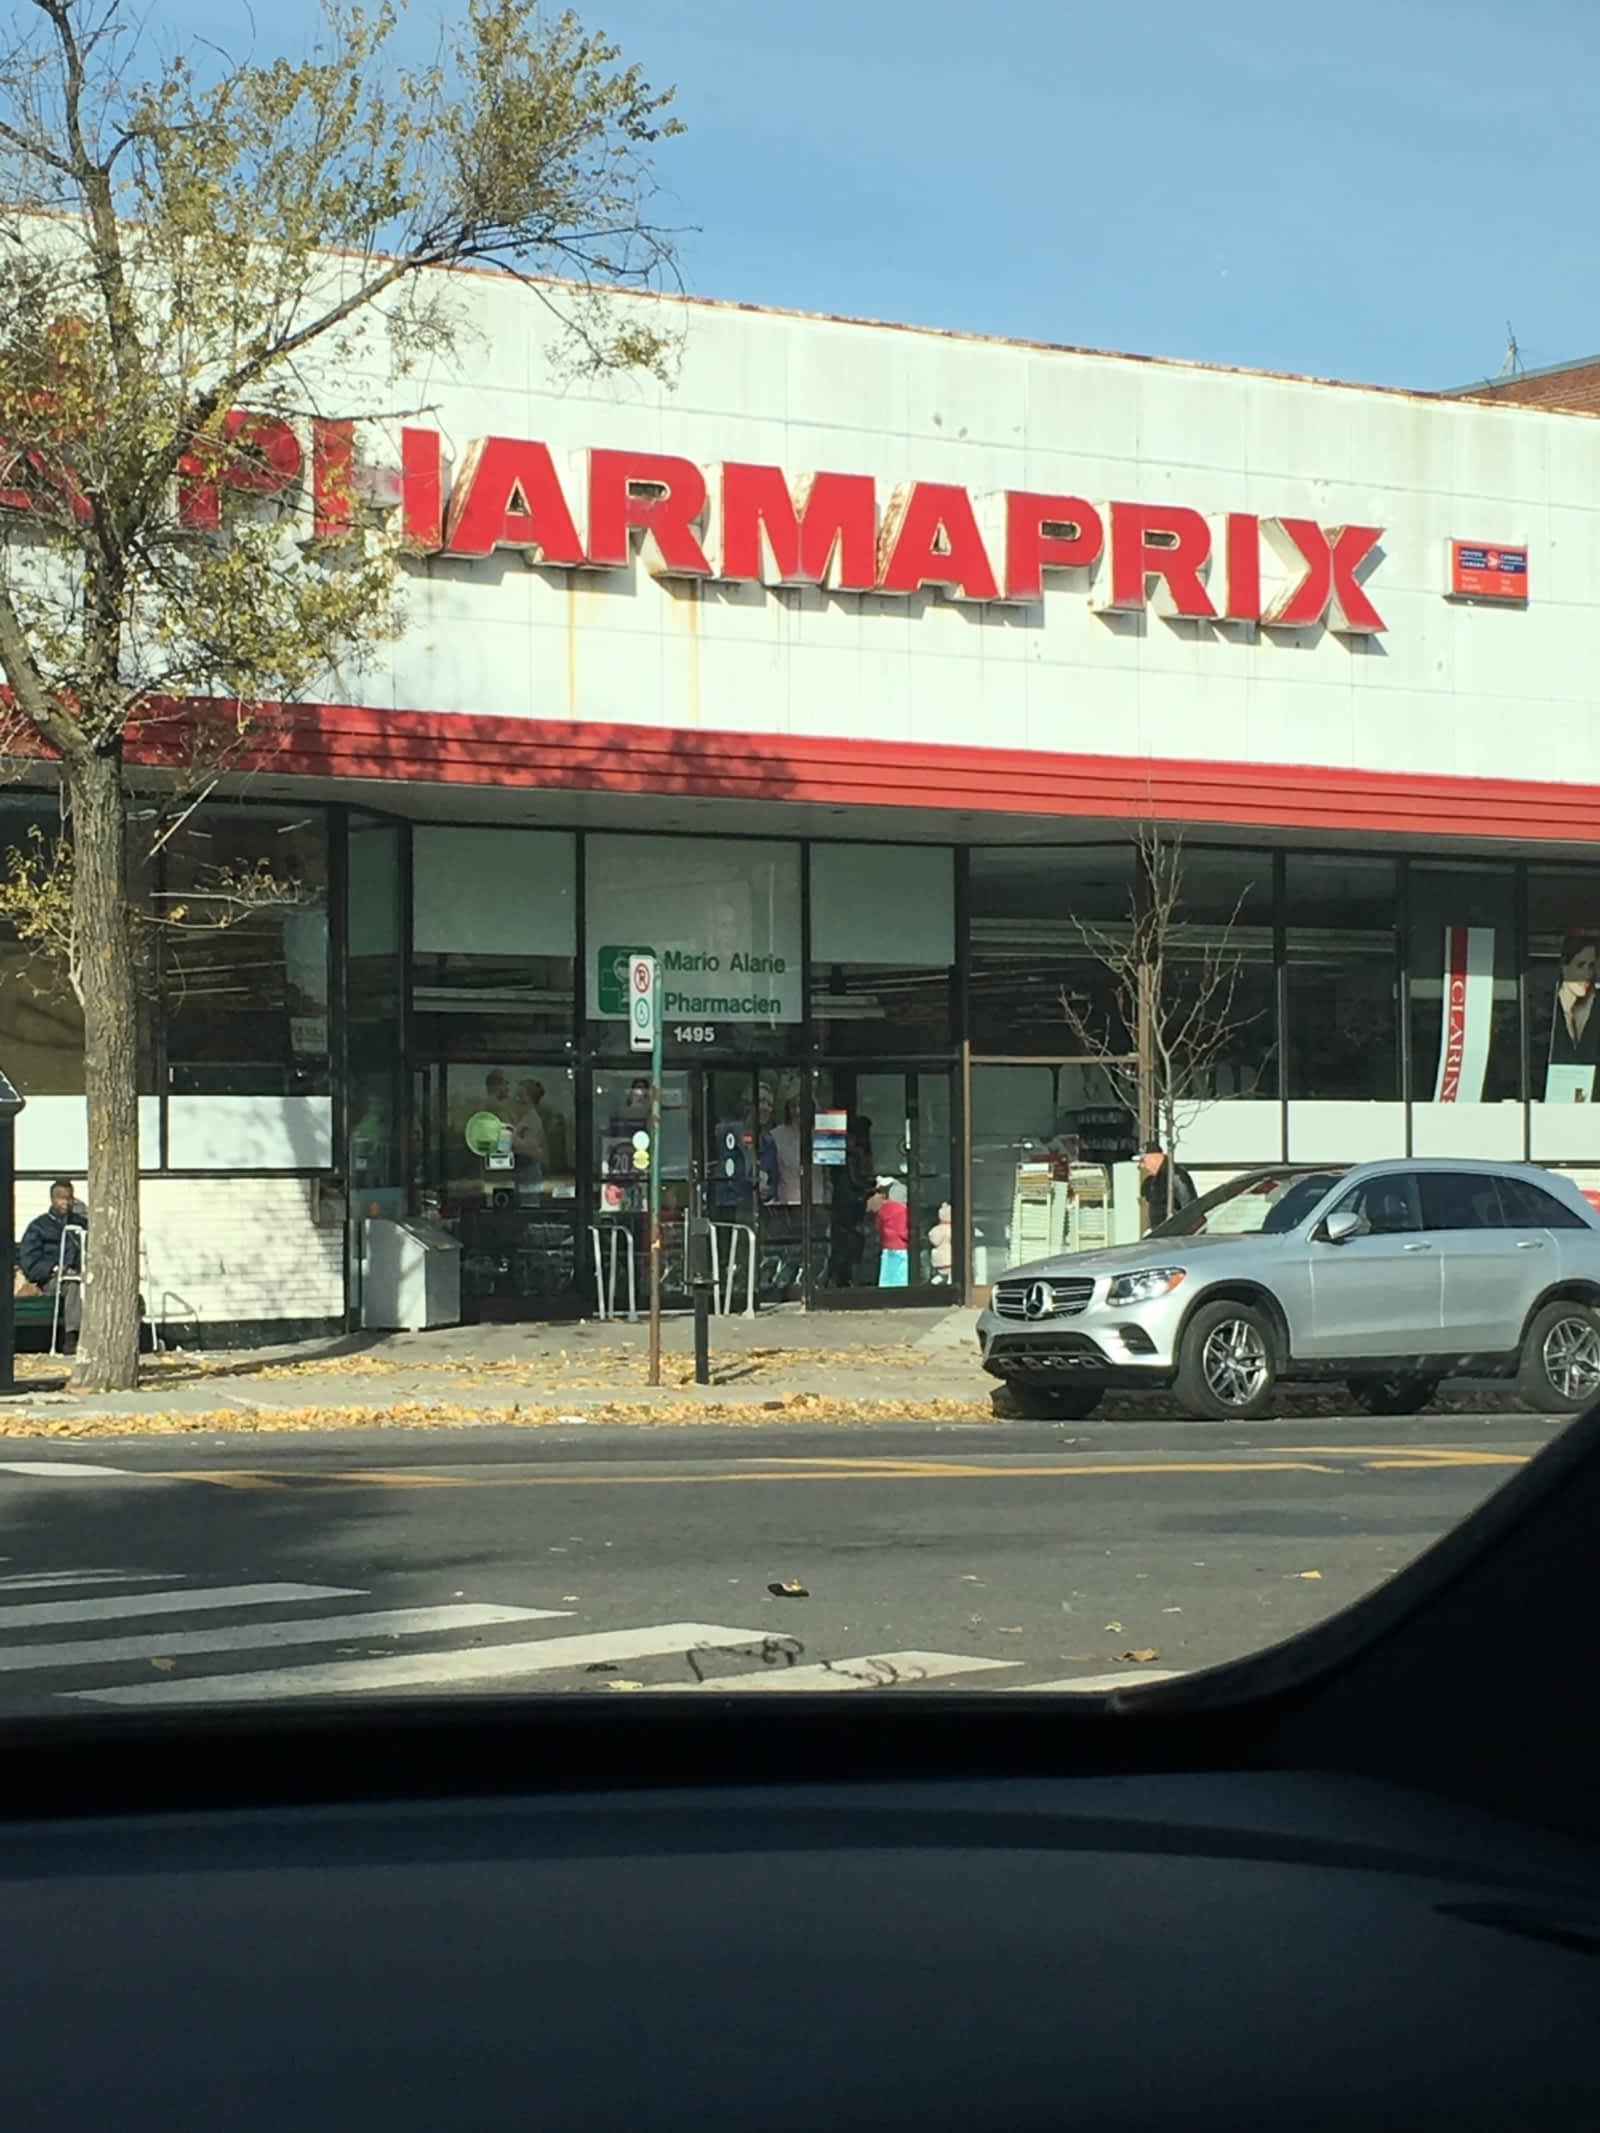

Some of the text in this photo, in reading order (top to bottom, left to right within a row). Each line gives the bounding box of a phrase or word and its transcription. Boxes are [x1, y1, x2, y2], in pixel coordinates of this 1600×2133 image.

[664, 951, 786, 973] Mario Alarie
[664, 992, 782, 1014] Pharmacien
[673, 1027, 715, 1042] 1495
[1441, 980, 1465, 1103] CLARIN
